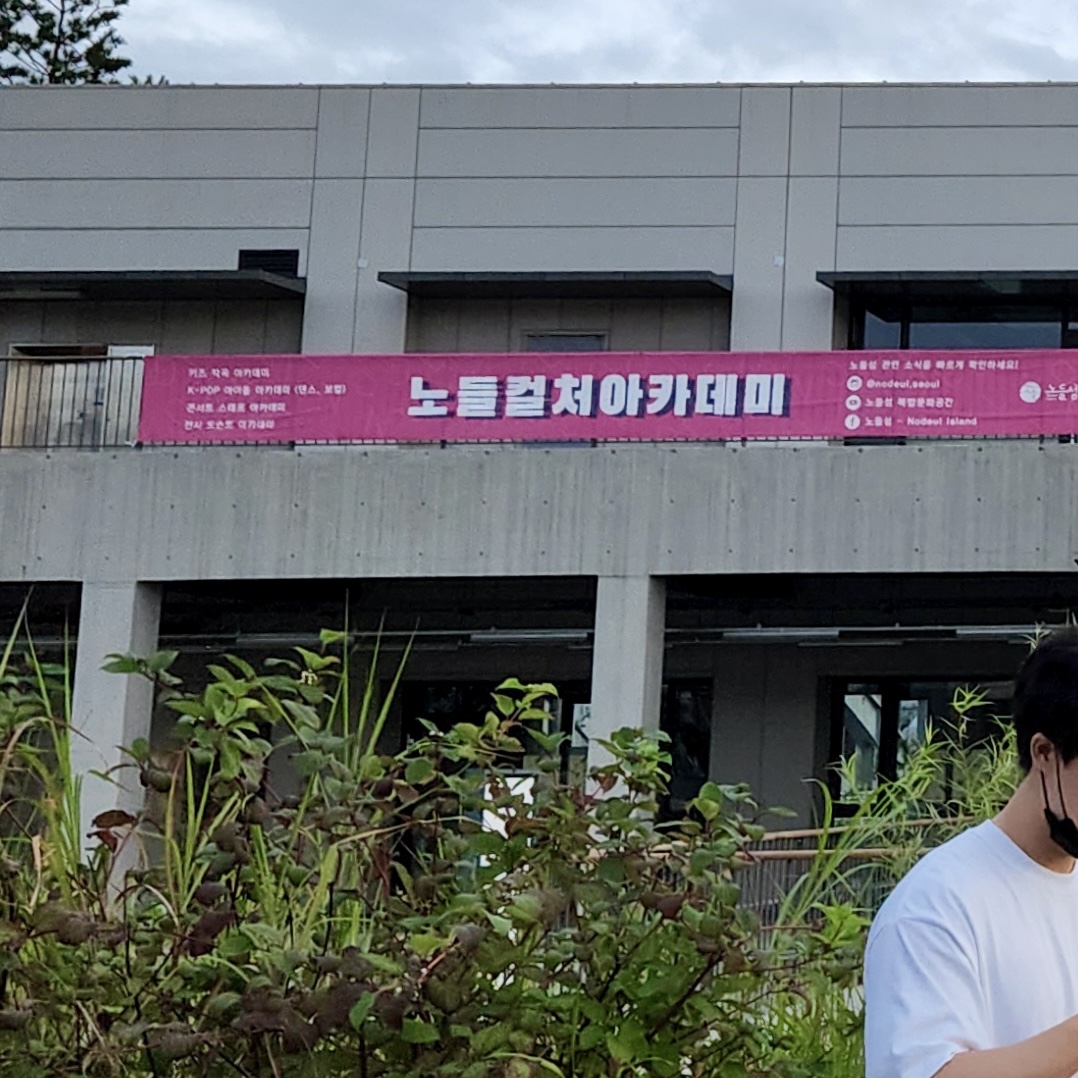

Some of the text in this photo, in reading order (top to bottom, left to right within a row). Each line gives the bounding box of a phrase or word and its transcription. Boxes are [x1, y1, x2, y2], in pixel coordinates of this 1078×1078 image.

[848, 360, 878, 371] 노들섬
[903, 360, 931, 370] 소식을
[935, 360, 965, 370] 빠르게
[968, 360, 1019, 370] 확인하세요!
[233, 367, 271, 378] 아카데미
[187, 385, 220, 395] K-POP
[255, 384, 291, 395] 아카데미
[866, 379, 940, 389] @nodeul.seoul
[407, 373, 791, 418] 노들컬처아카데미
[249, 402, 286, 413] 아카데미
[864, 397, 954, 408] 노들섬 복합문화공간
[237, 419, 276, 430] 아카데미
[864, 416, 892, 427] 노들섬
[907, 416, 943, 427] Nodeul
[946, 416, 978, 427] Island
